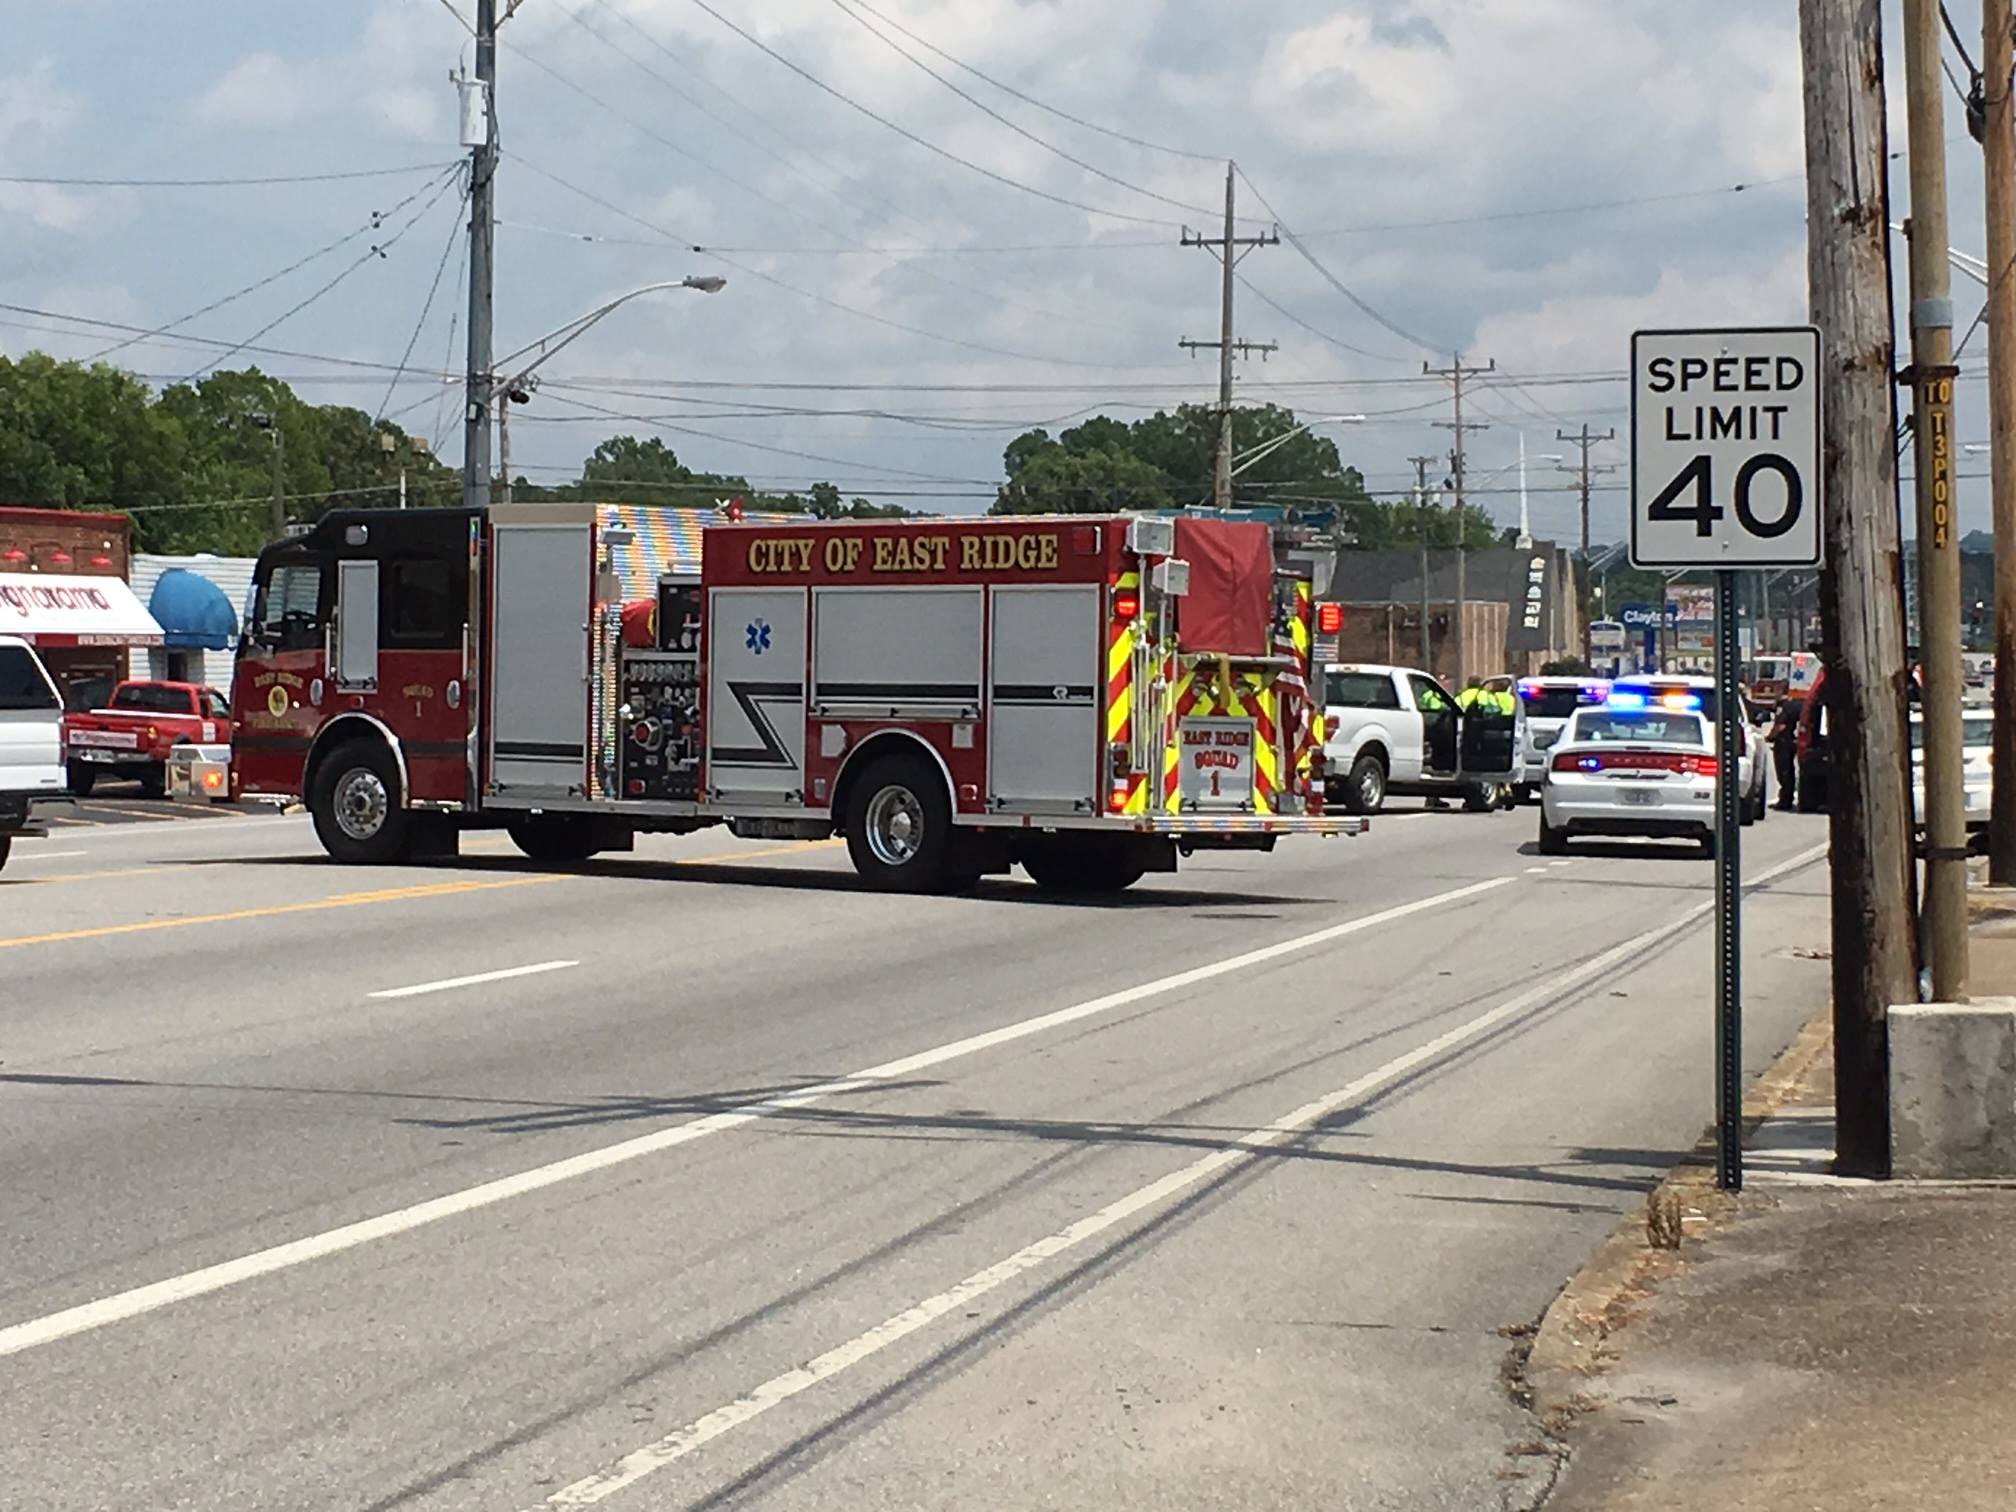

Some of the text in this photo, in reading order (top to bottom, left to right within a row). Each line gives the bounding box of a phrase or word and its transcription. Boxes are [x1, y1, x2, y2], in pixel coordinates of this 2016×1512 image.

[1648, 357, 1804, 393] SPEED
[1665, 406, 1789, 441] LIMIT
[1647, 453, 1803, 539] 40
[750, 533, 1059, 573] CITY OF EAST RIDGE
[1183, 730, 1249, 746] EAST RIDGE
[1194, 750, 1239, 769] SQUAD
[1210, 770, 1220, 796] 1
